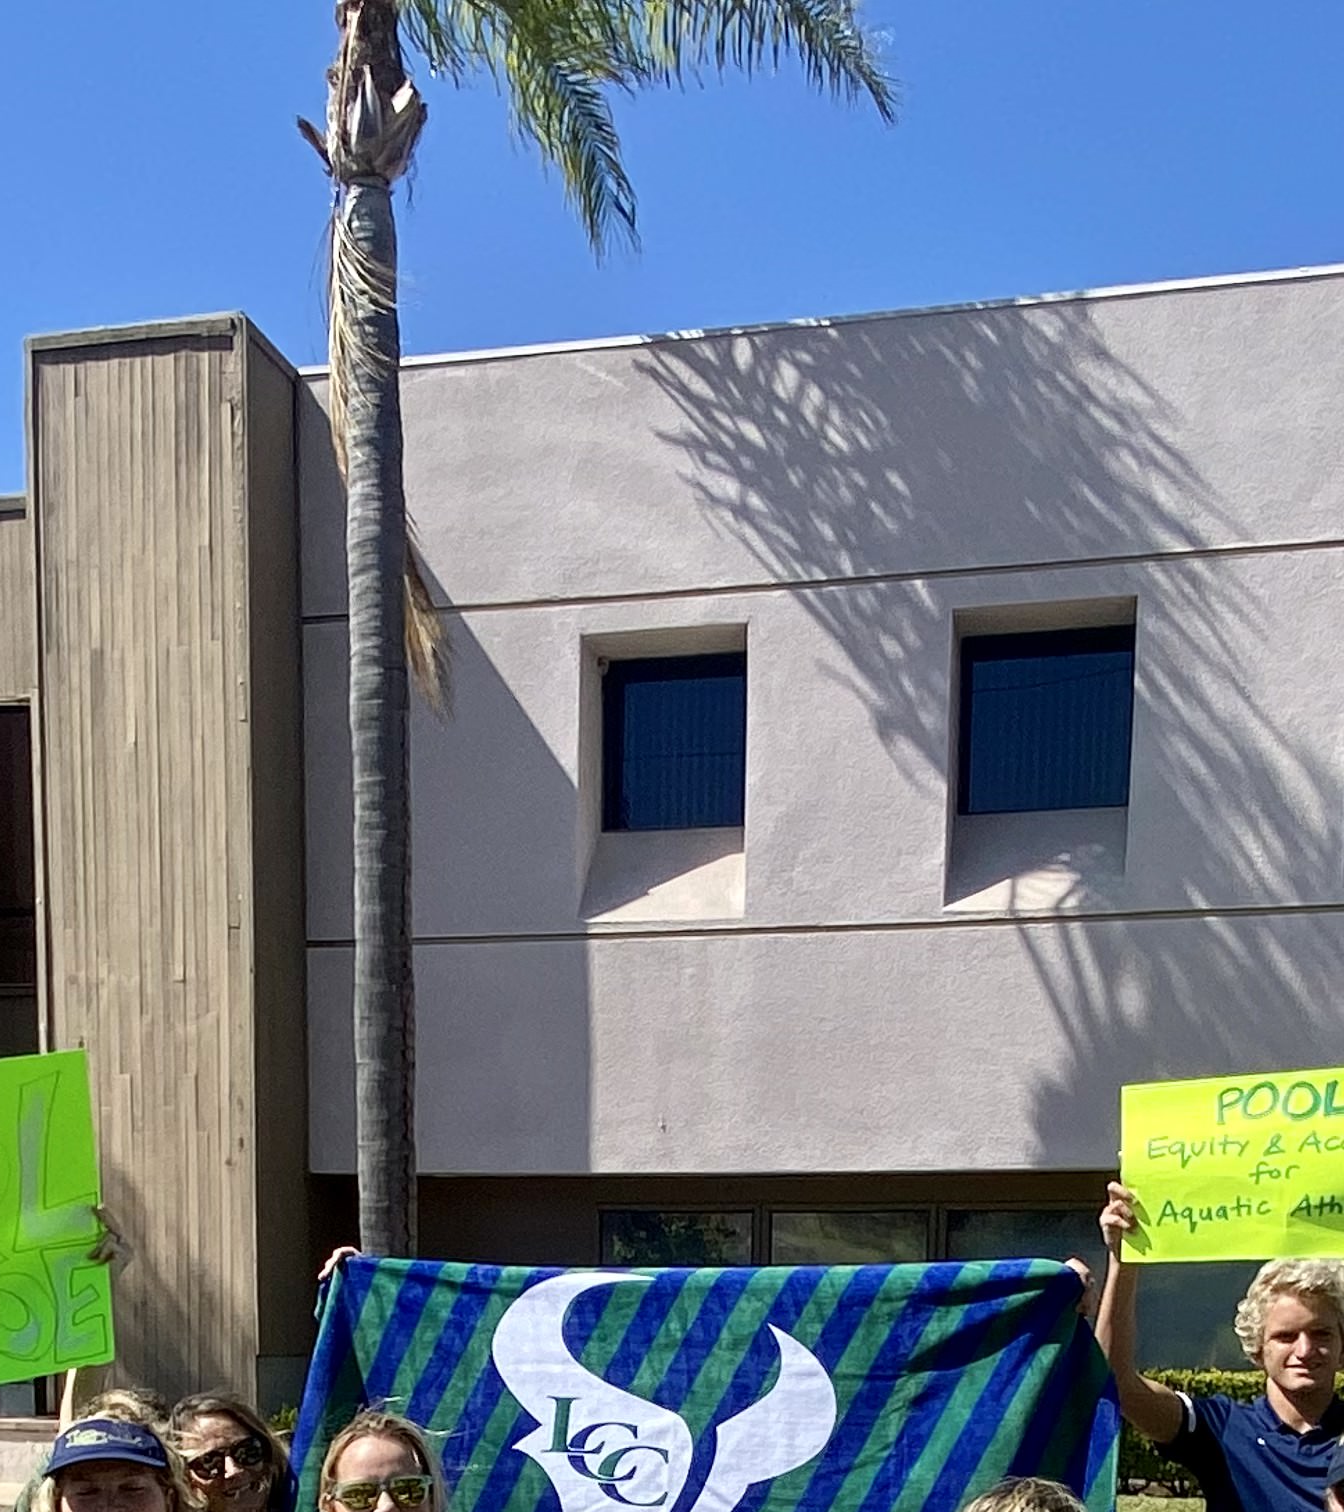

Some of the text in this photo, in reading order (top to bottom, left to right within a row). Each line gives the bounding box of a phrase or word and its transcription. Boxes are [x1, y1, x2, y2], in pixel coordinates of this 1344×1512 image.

[1147, 1134, 1251, 1169] Equity
[1262, 1133, 1286, 1157] &
[1247, 1160, 1301, 1185] for
[1156, 1195, 1272, 1234] Aquatic
[540, 1394, 670, 1507] LCC
